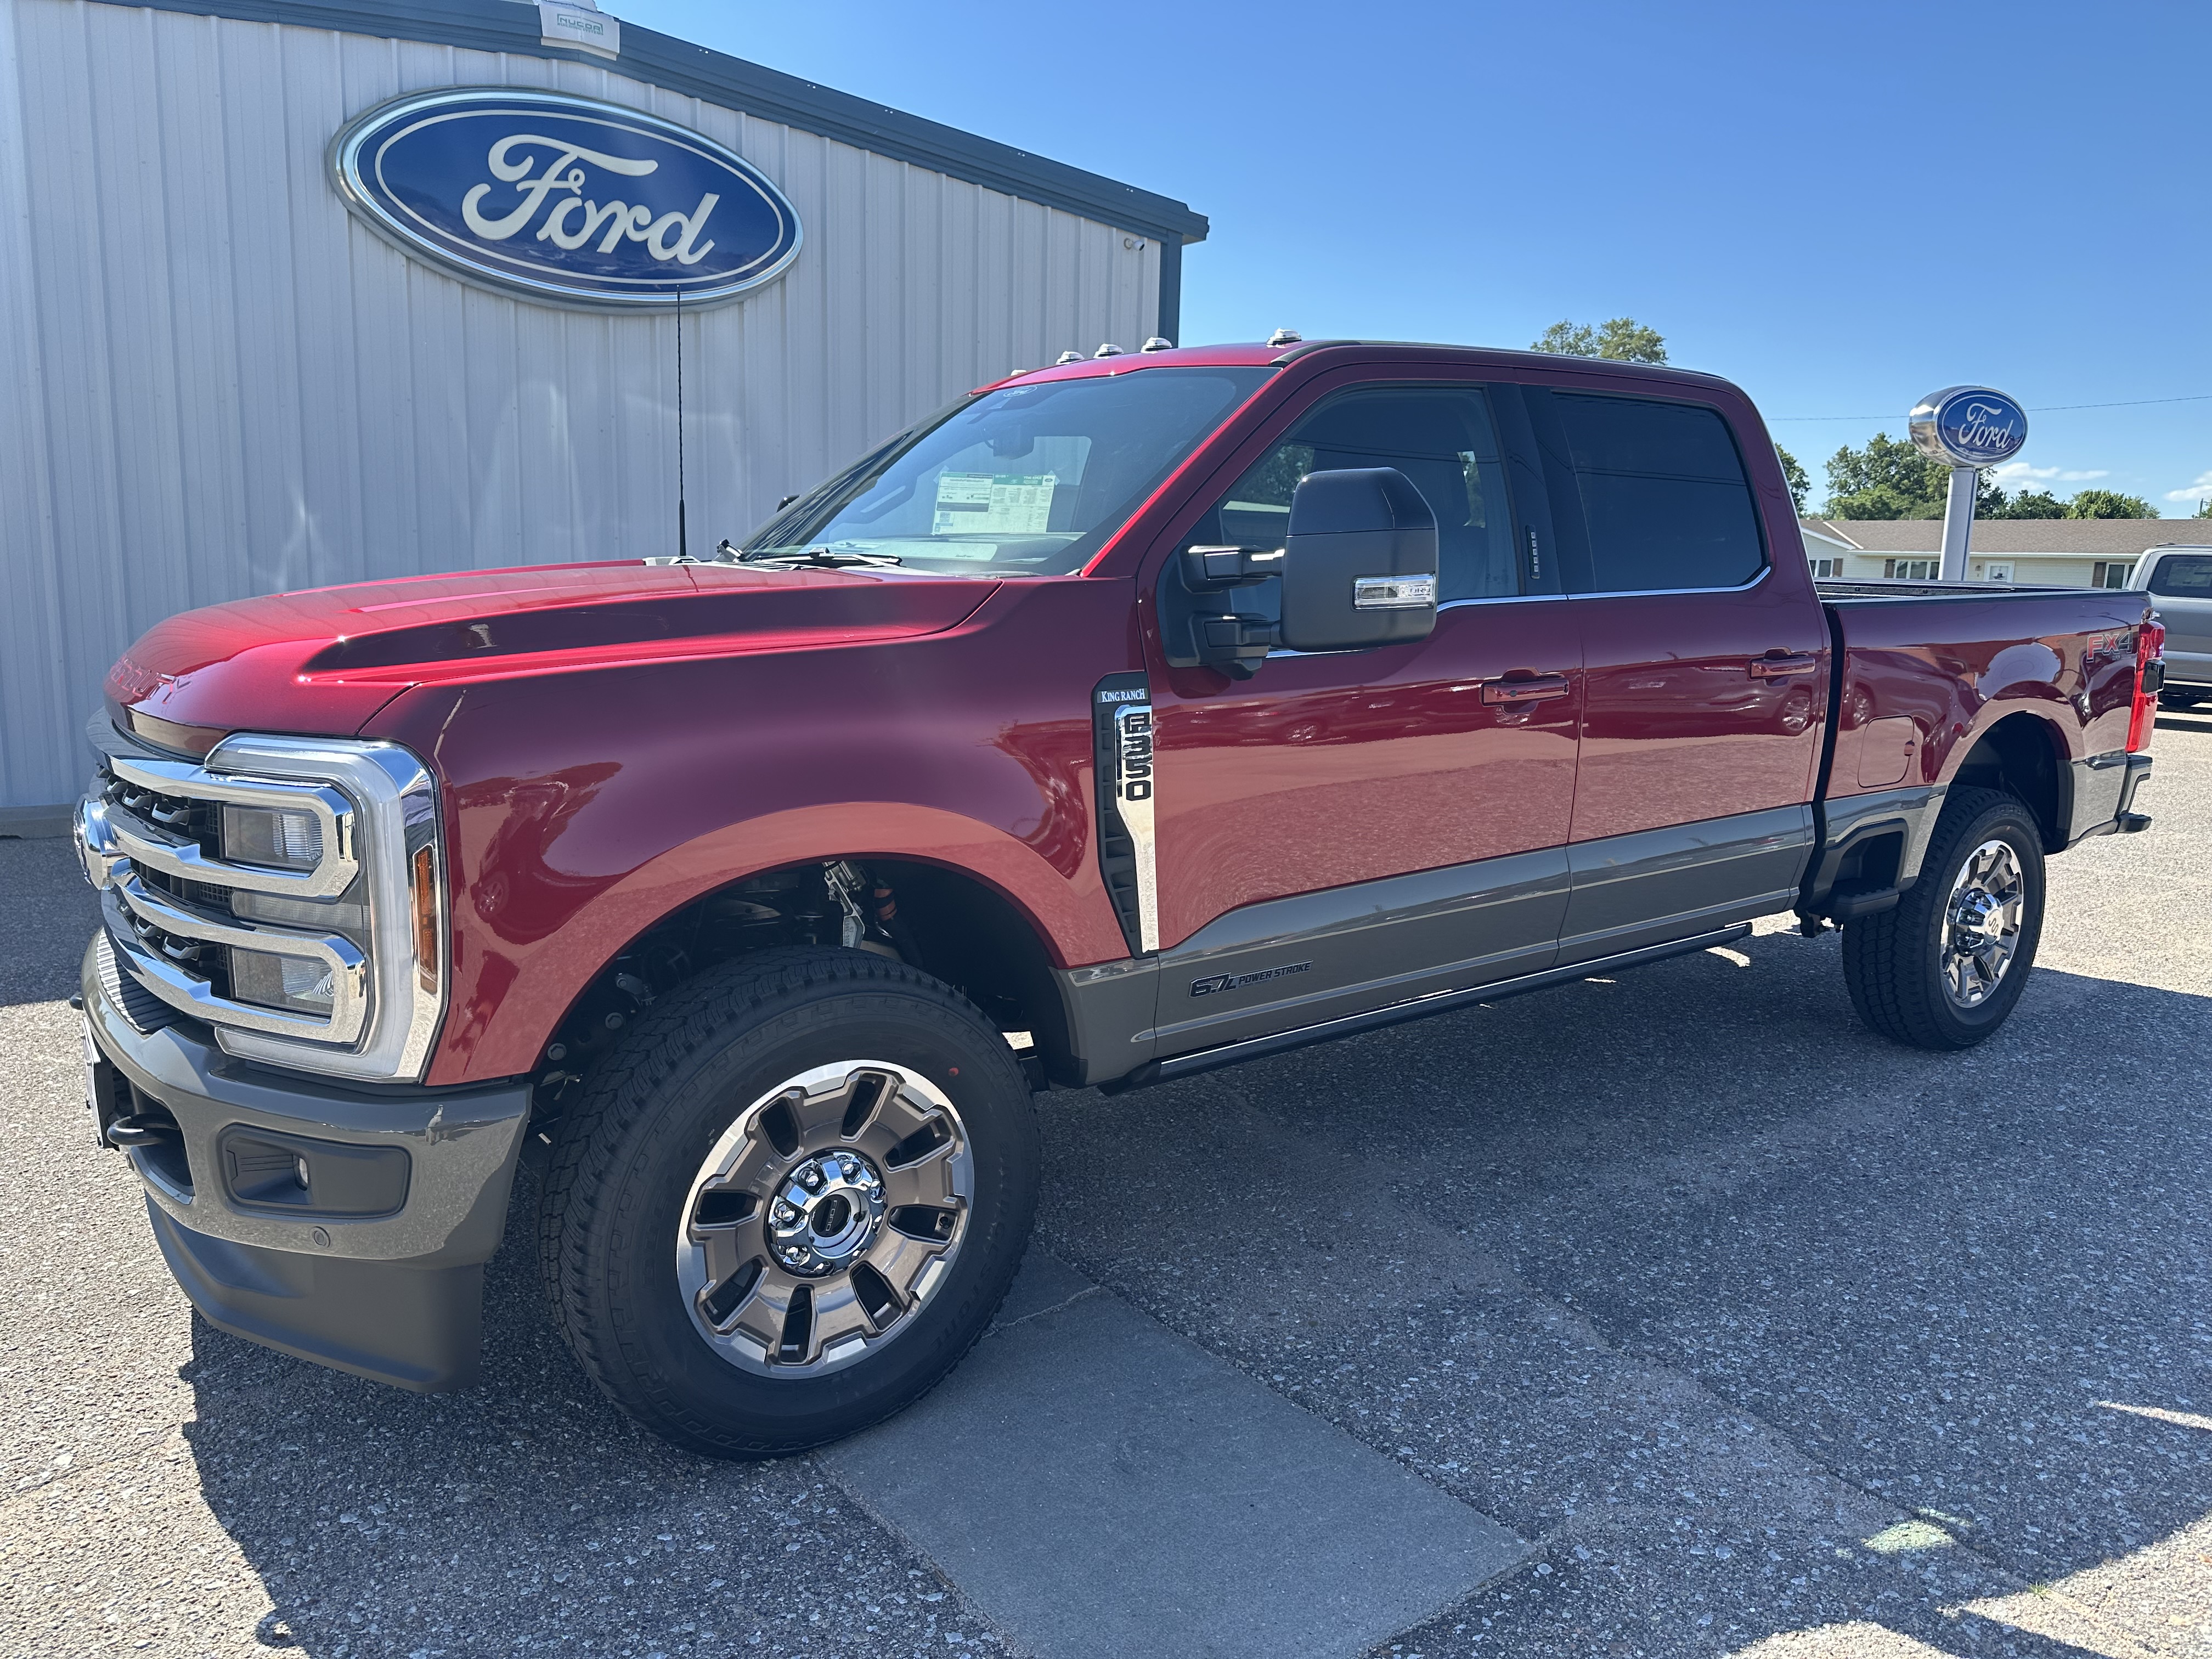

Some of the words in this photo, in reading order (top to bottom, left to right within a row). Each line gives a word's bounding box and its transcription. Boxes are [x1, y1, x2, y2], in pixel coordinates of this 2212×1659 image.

[560, 18, 601, 32] NUCOR
[461, 133, 721, 265] Ford
[1958, 403, 2013, 449] Ford
[2086, 630, 2133, 663] FX4
[1101, 691, 1120, 702] KING
[1120, 688, 1146, 701] RANCH
[1124, 712, 1152, 802] F350
[1188, 972, 1237, 998] 6.7L
[1238, 970, 1272, 985] POWER
[1273, 962, 1311, 978] STROKE
[825, 1199, 839, 1233] FORD
[924, 1138, 1012, 1357] BRIDGESTONE
